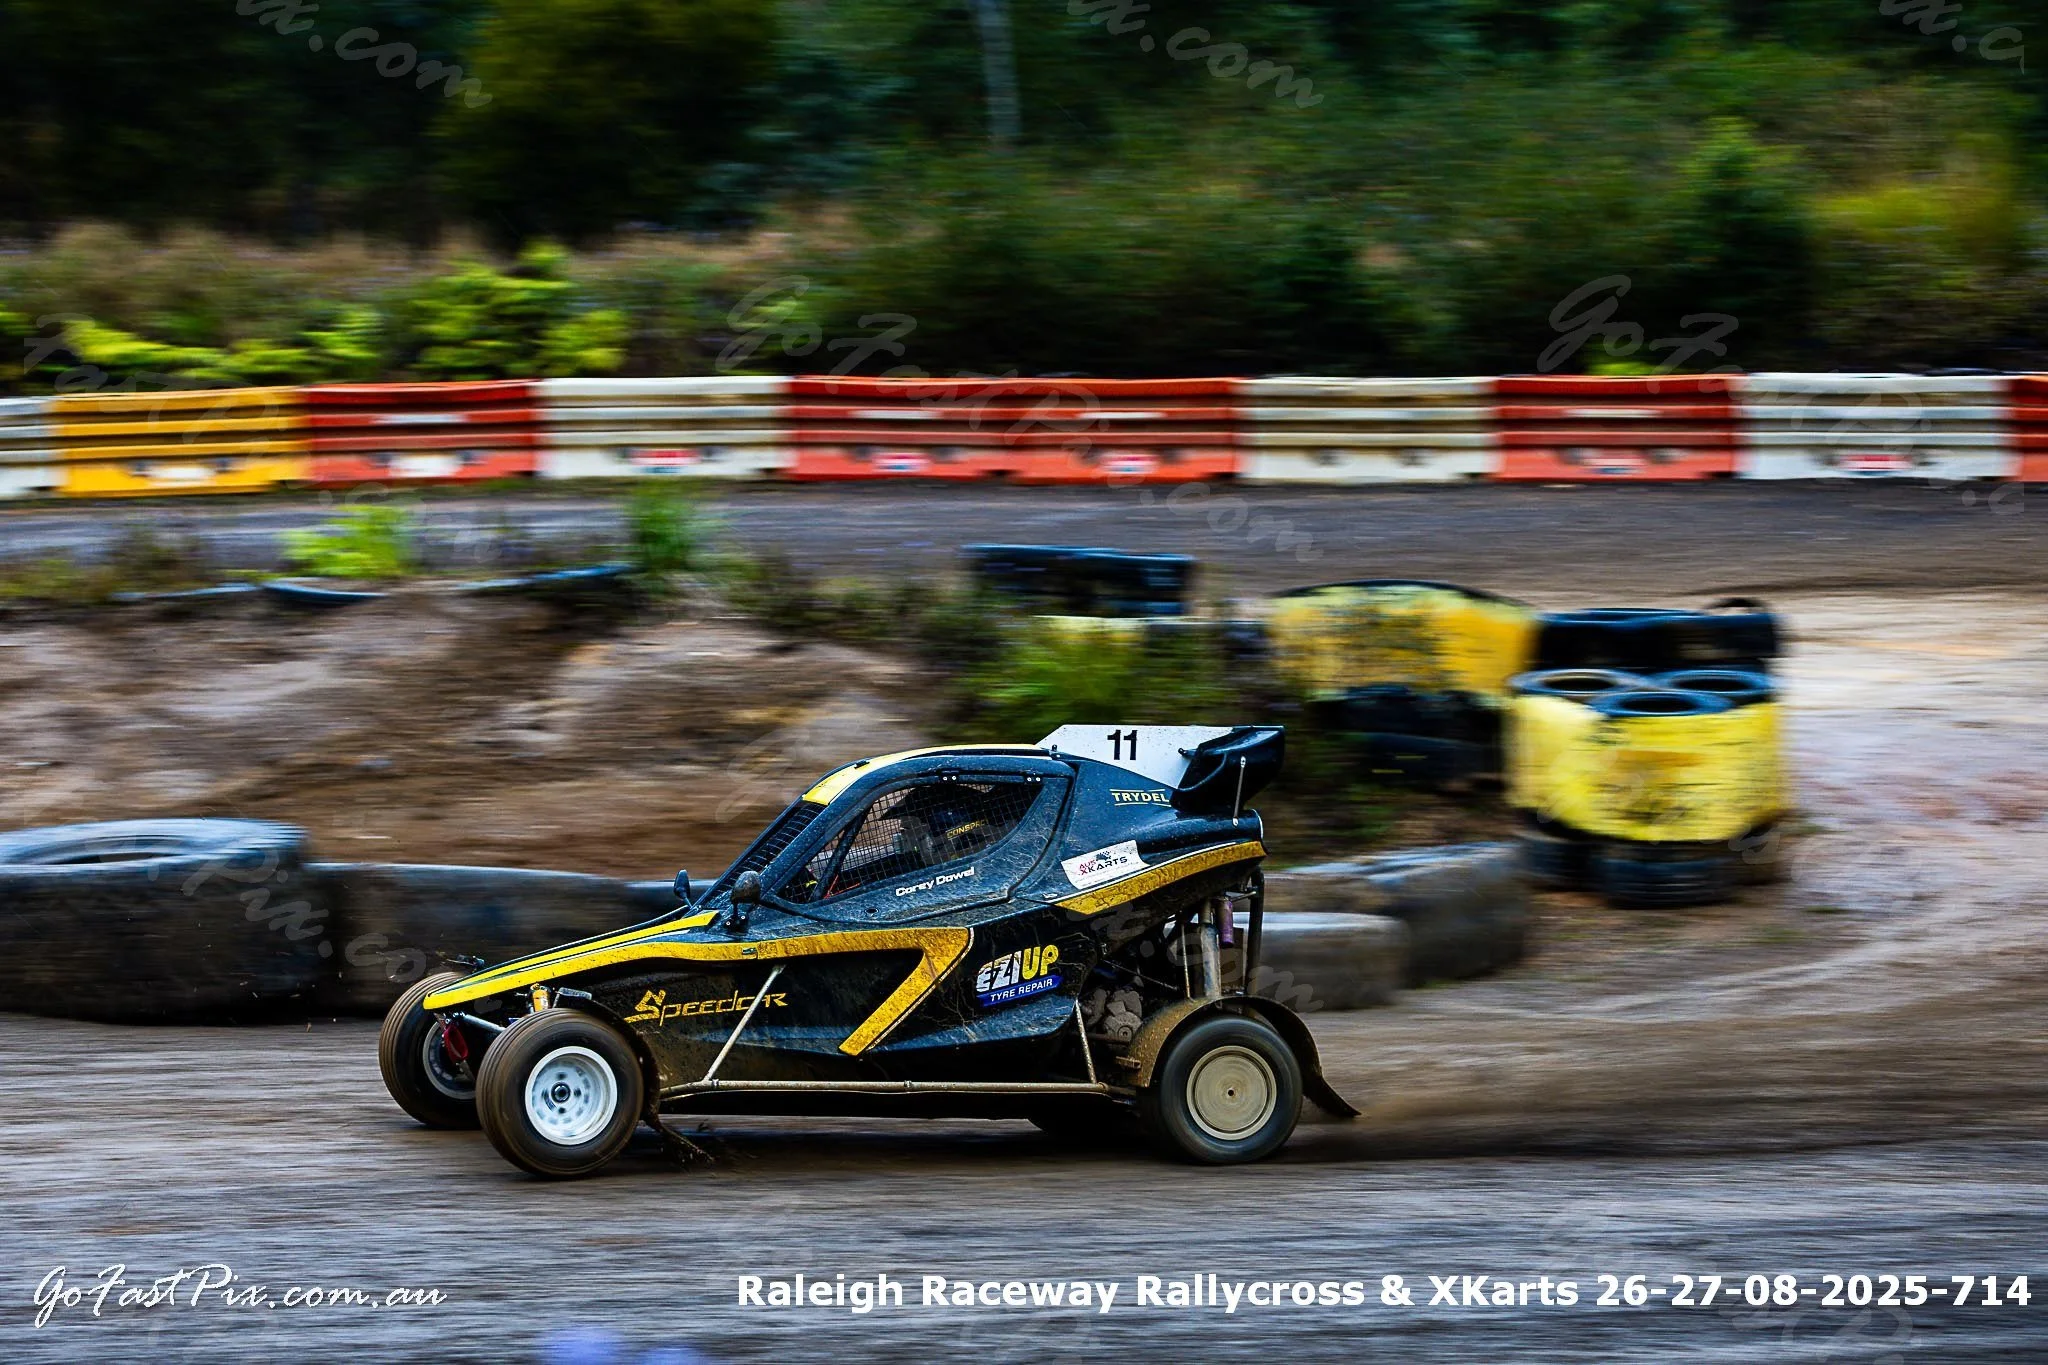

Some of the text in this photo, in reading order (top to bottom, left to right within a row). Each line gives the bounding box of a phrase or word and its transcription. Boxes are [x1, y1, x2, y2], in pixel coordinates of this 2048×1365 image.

[1107, 729, 1138, 761] 11
[896, 880, 934, 897] Corey
[990, 978, 1053, 1002] TYRE REPAIR
